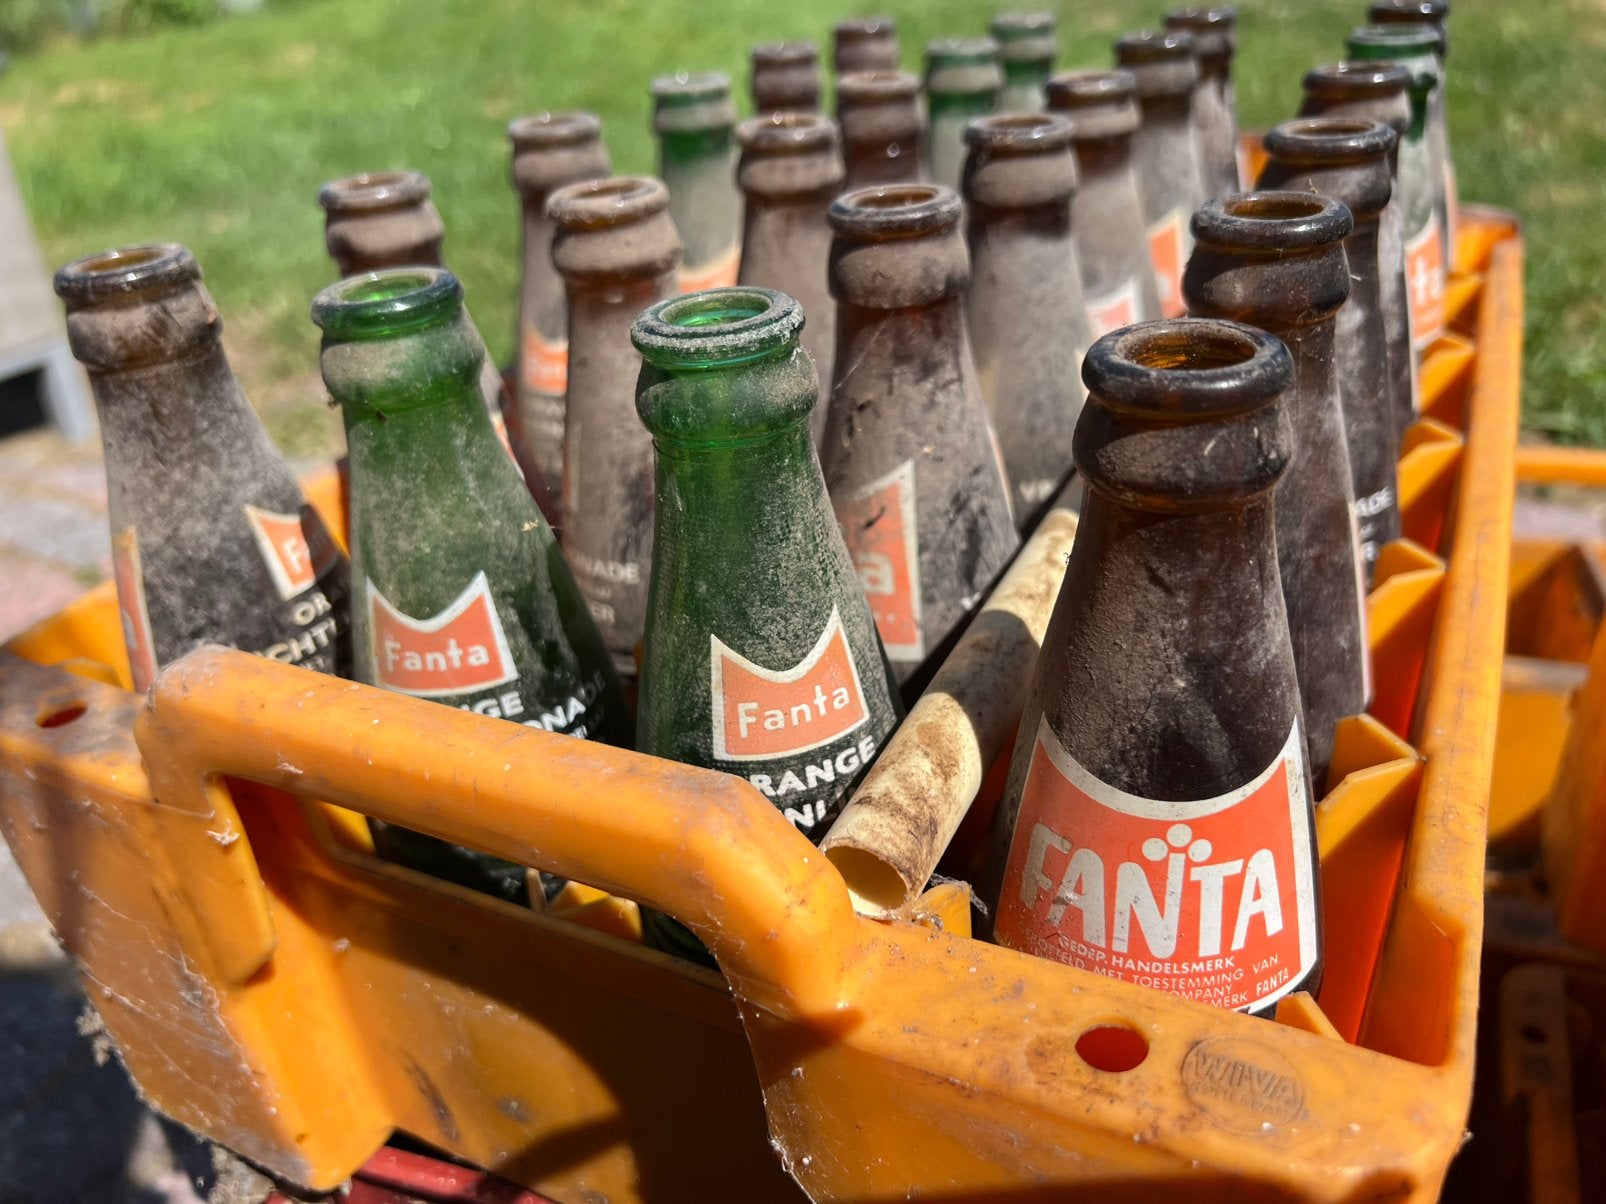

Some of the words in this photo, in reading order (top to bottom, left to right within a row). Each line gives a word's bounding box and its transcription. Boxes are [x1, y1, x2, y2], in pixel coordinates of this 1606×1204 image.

[383, 637, 489, 673] Fanta
[737, 683, 850, 738] Fanta
[750, 735, 876, 797] RANGE
[1018, 822, 1284, 959] FANTA
[1111, 955, 1235, 974] HANDELSMERK
[1132, 968, 1244, 990] TOESTEMMING
[1252, 953, 1279, 974] VAN
[1256, 967, 1289, 997] FANTA
